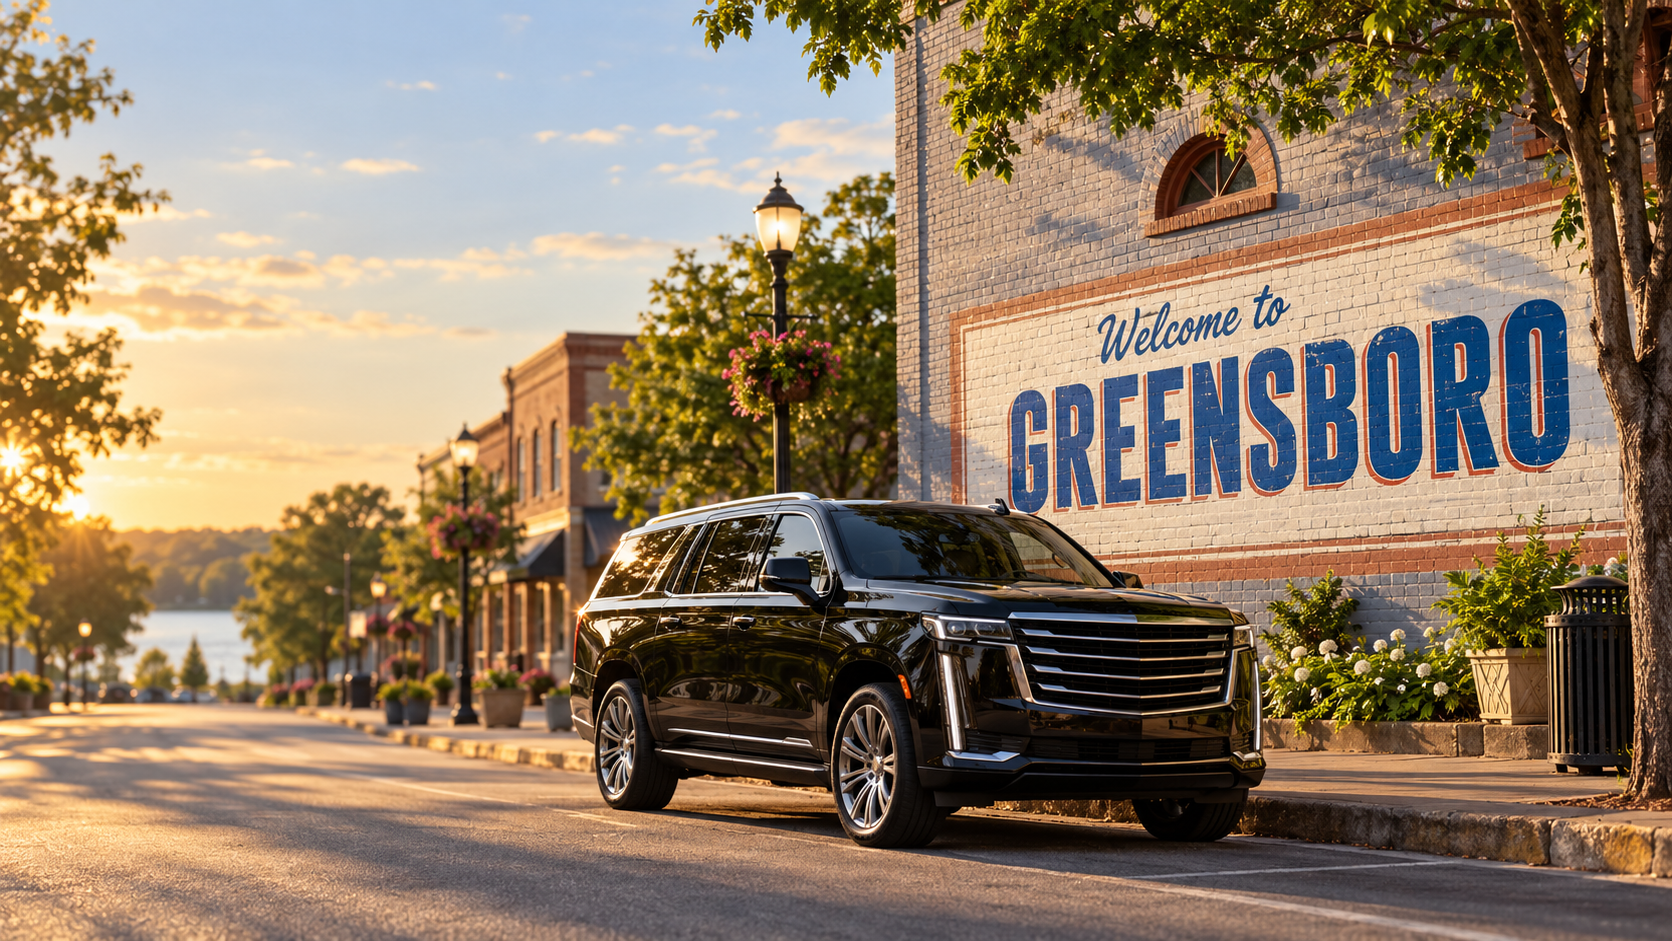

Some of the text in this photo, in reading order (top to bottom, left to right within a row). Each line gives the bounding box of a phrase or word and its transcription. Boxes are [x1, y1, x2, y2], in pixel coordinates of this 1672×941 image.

[1098, 285, 1290, 364] Welcome to
[1008, 298, 1571, 515] GREENSBORO
